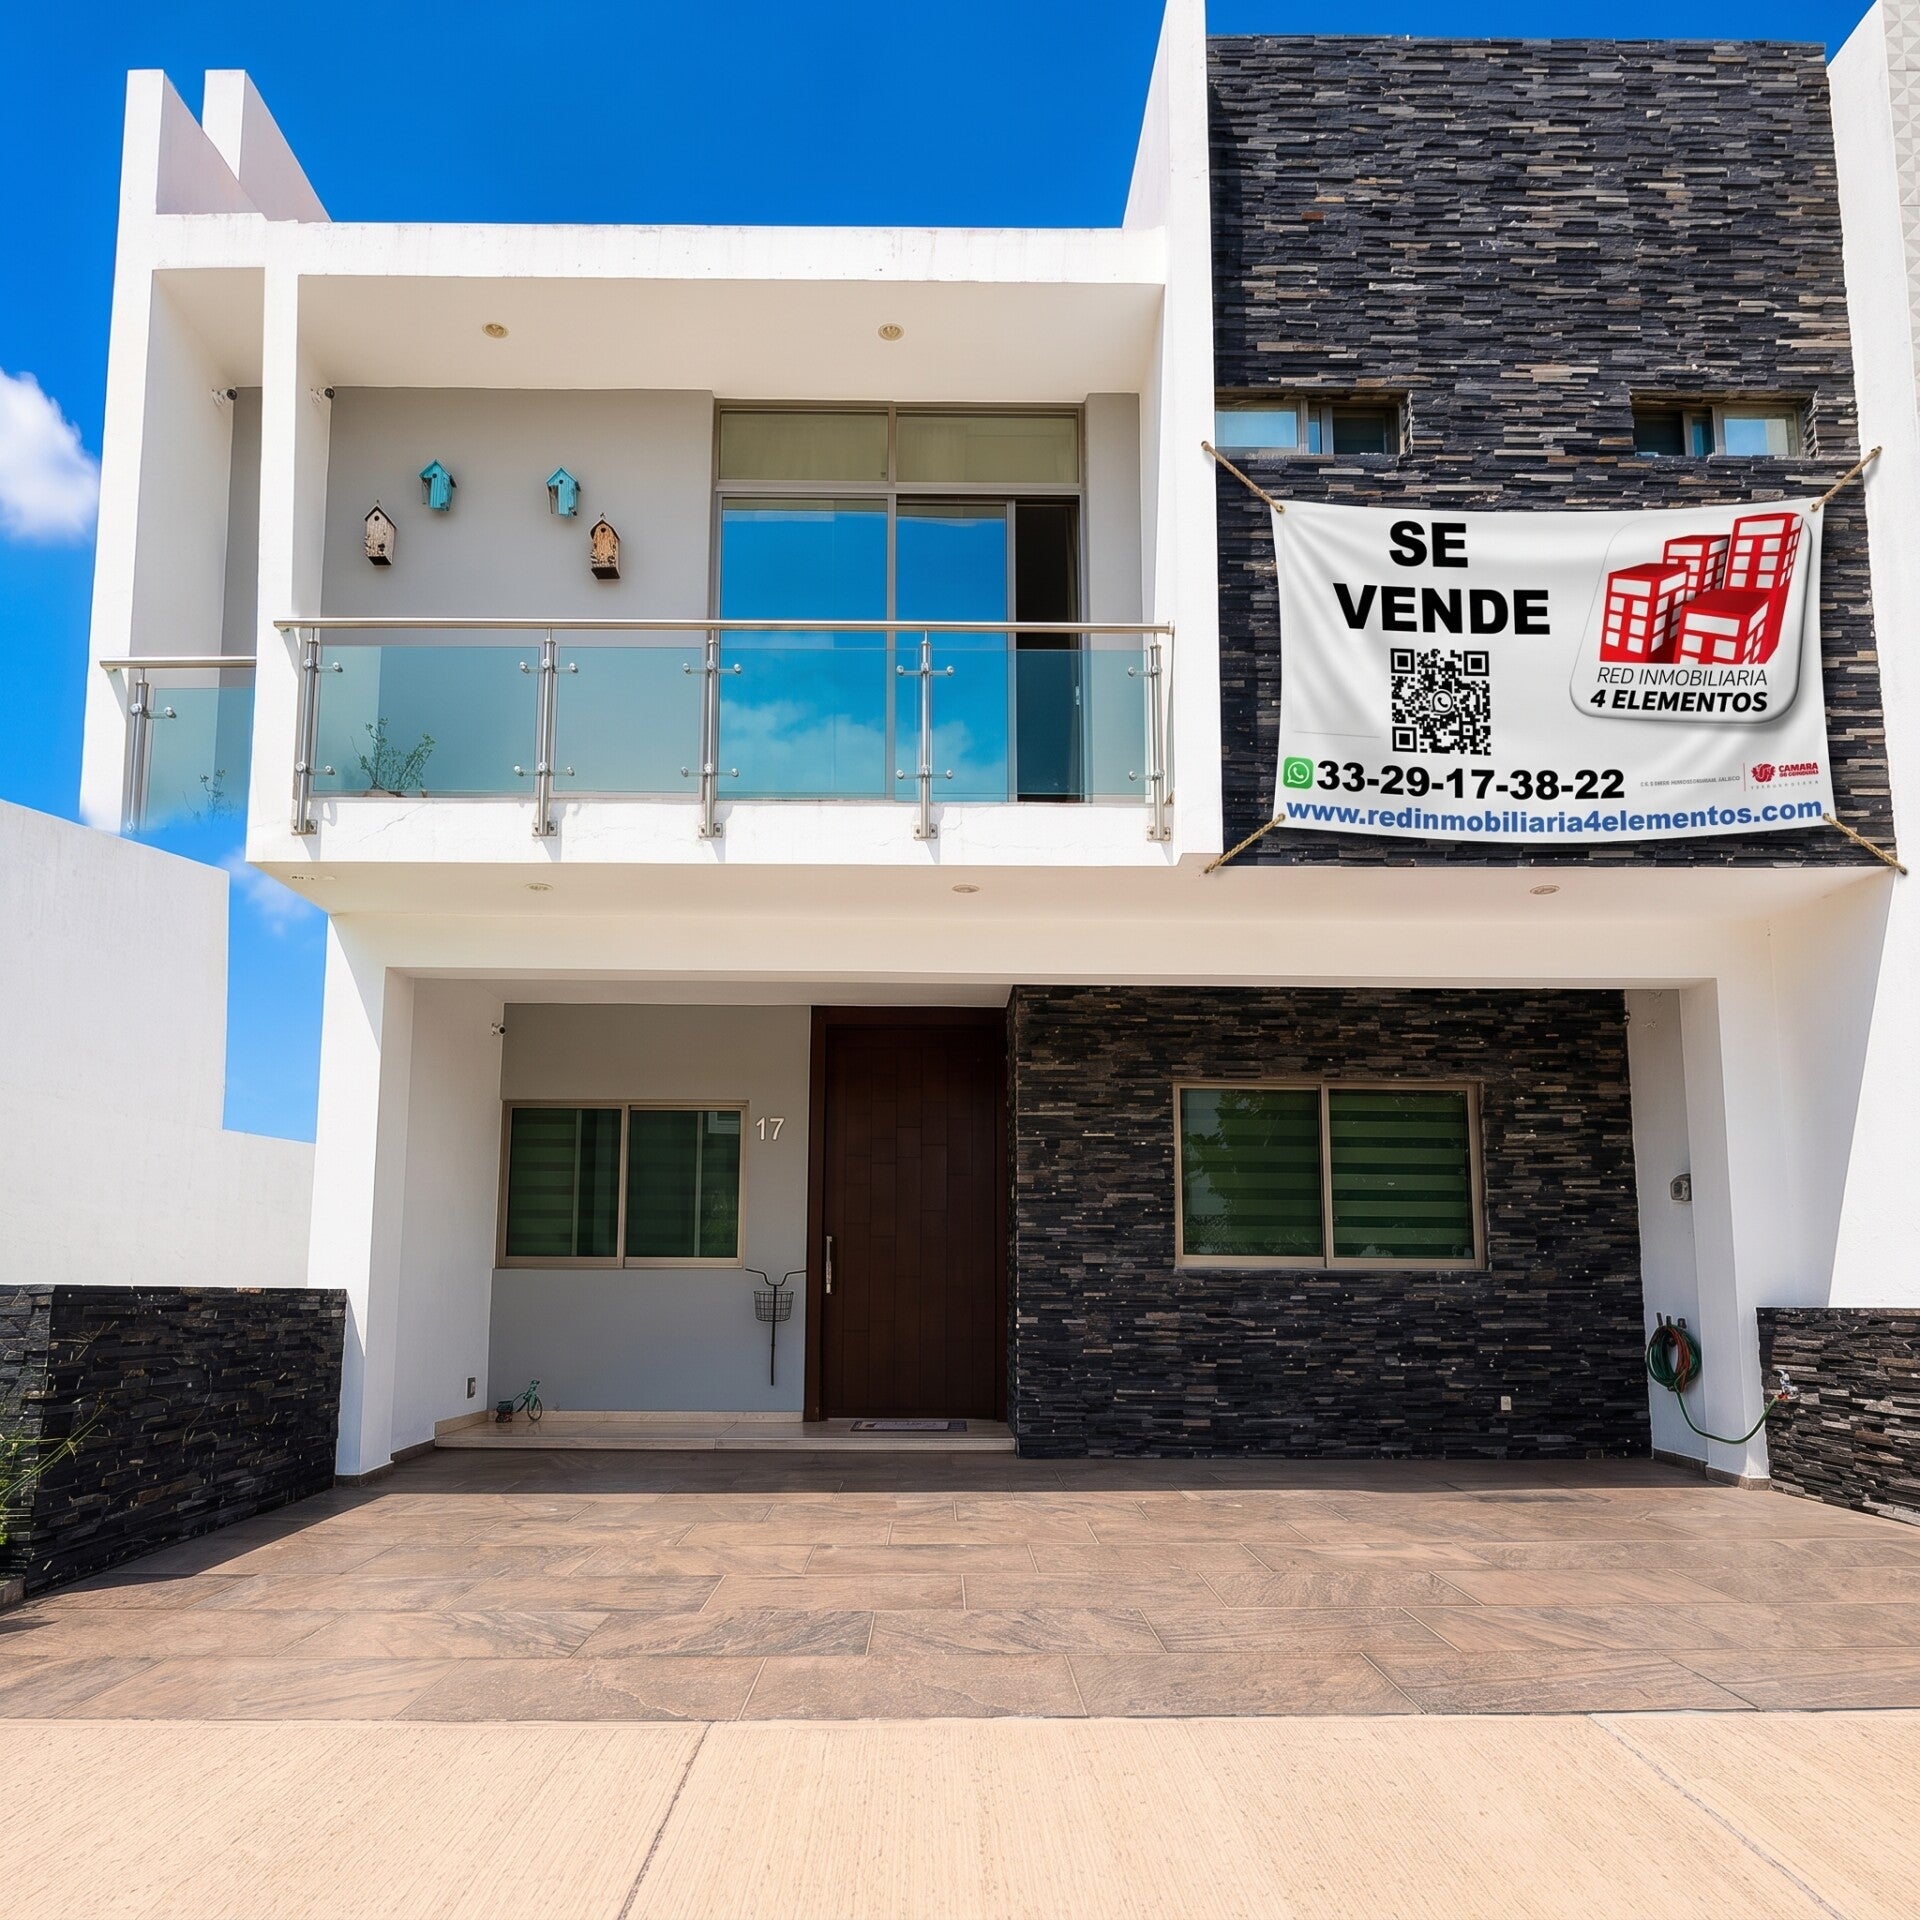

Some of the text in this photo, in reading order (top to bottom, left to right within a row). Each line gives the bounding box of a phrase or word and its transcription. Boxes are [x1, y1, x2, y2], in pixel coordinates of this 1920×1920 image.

[1390, 521, 1468, 568] SE
[1333, 583, 1550, 635] VENDE
[1597, 667, 1768, 687] RED INMOBILIARIA
[1590, 690, 1768, 712] 4 ELEMENTOS
[1317, 760, 1625, 800] 33-29-17-38-22
[1286, 801, 1822, 833] www.redinmobiliaria4elementos.com
[756, 1117, 785, 1141] 17
